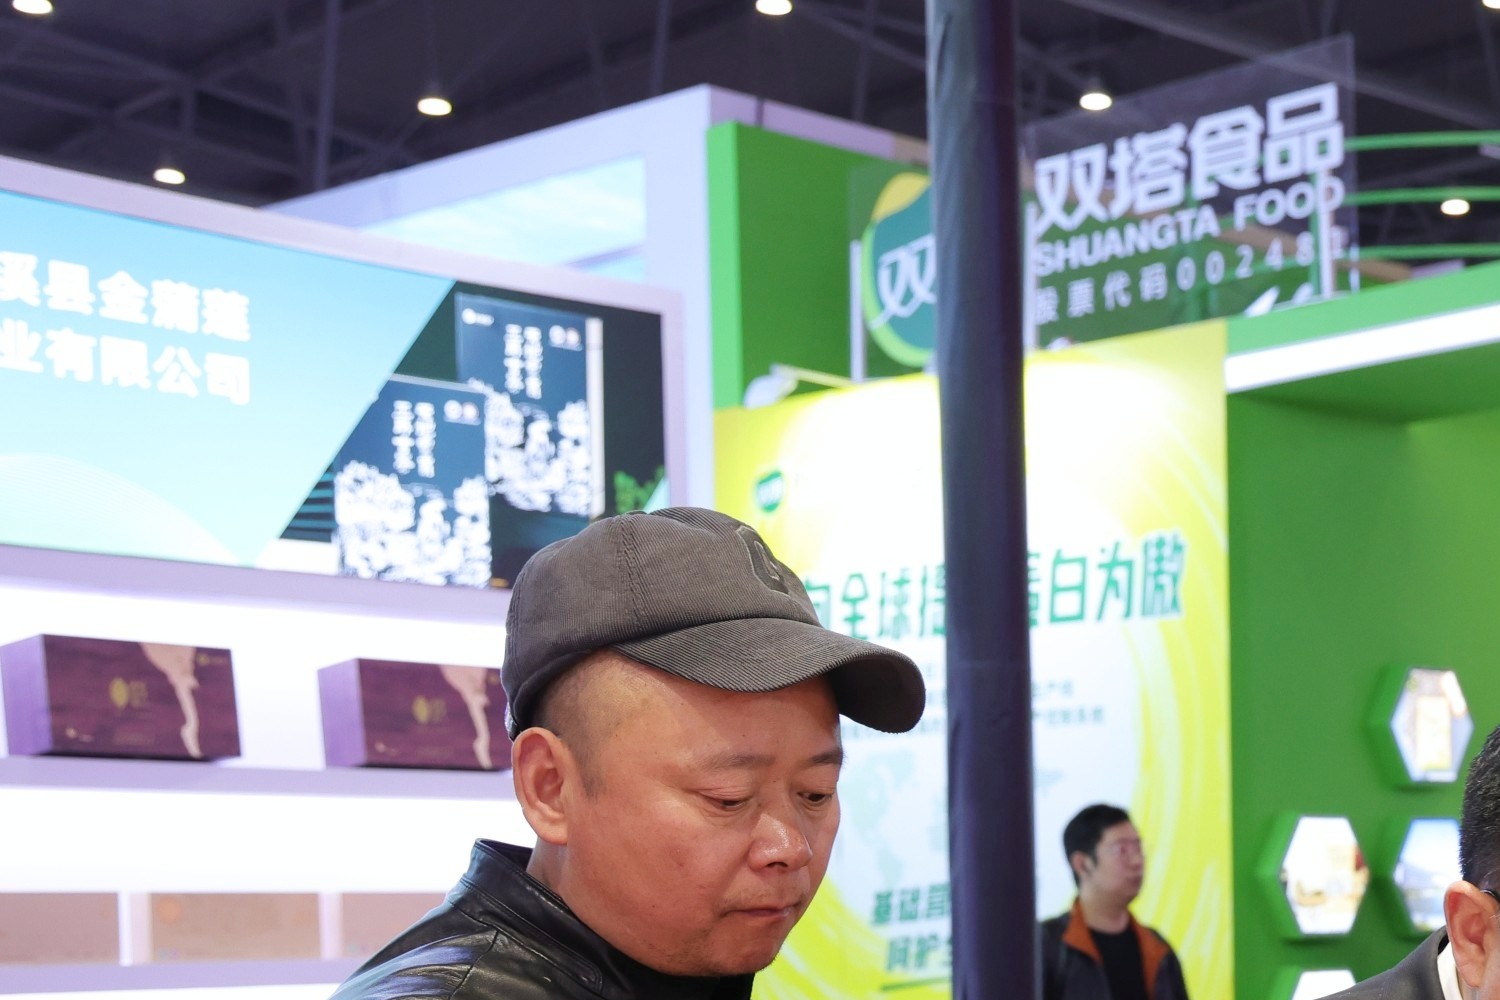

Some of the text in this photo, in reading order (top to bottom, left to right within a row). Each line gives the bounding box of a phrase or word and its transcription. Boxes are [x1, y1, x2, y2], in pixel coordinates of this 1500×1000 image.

[1033, 81, 1345, 239] 双塔食品
[1035, 175, 1346, 278] SHUANGTA FOOD
